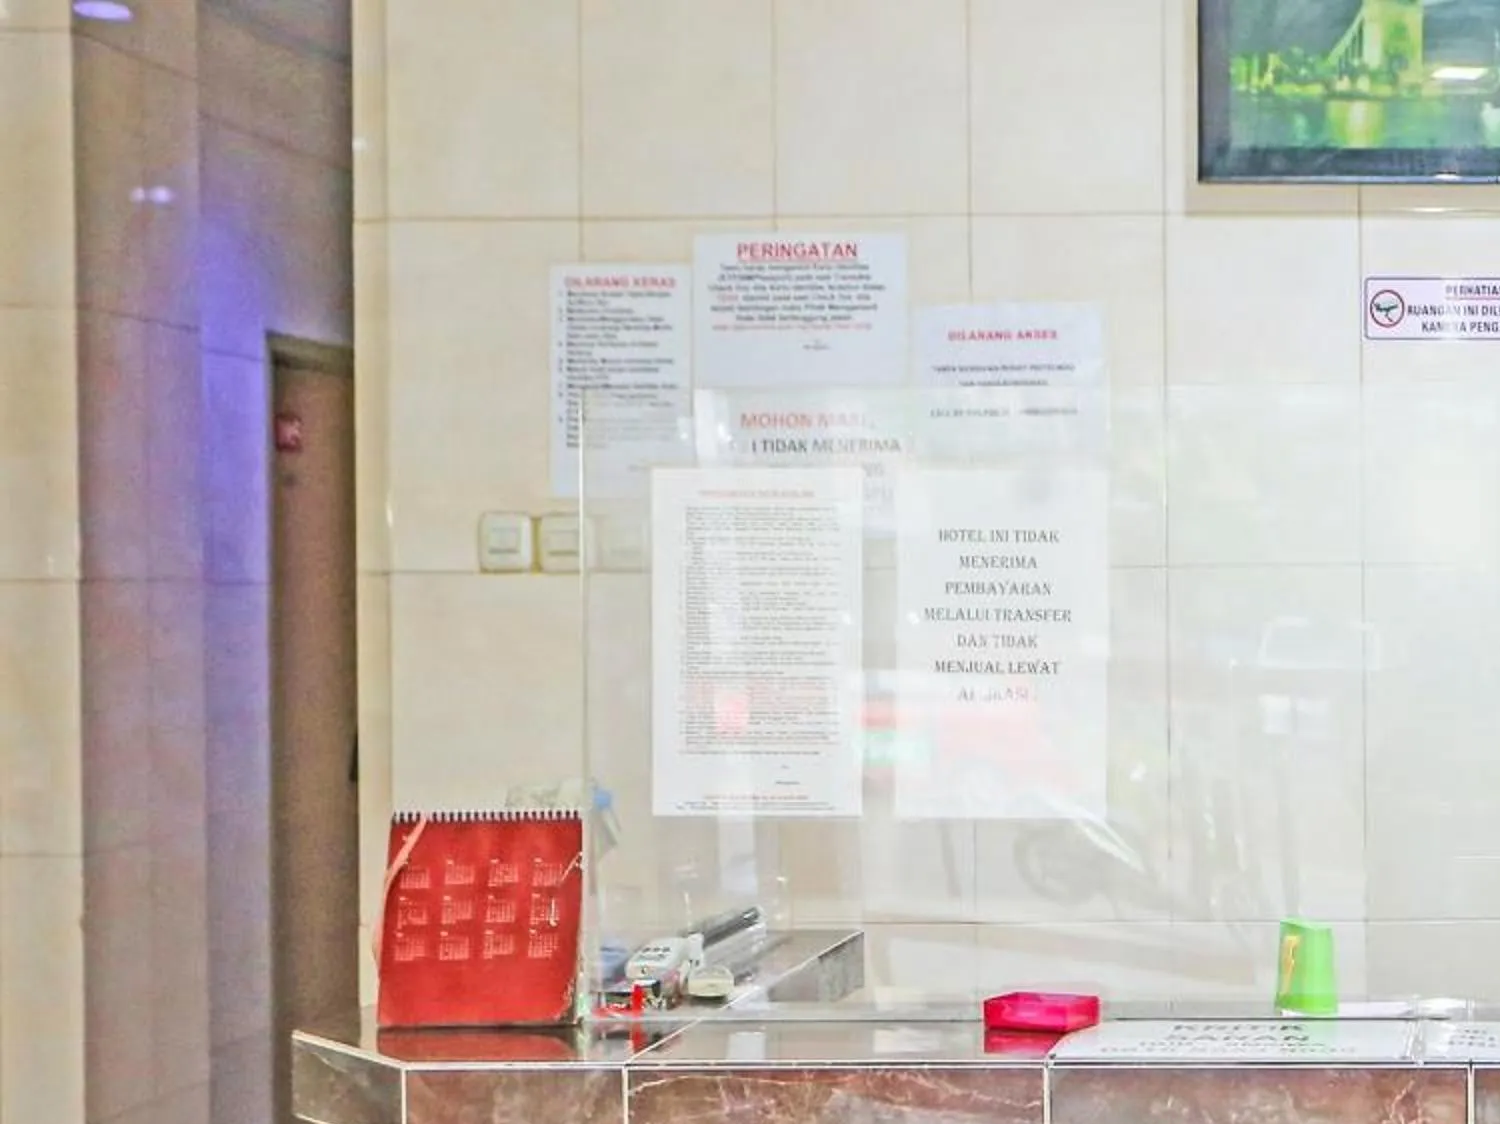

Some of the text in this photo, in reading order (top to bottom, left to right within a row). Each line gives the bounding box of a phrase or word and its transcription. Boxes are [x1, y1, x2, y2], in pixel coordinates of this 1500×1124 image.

[736, 242, 858, 257] PERINGATAN
[1463, 304, 1479, 317] INI
[1421, 321, 1467, 333] KAMA
[740, 412, 811, 428] MOHON
[761, 437, 808, 453] TIDAK
[938, 529, 1060, 544] HOTEL INI TIDAK
[959, 555, 1038, 570] MENERIMA
[944, 580, 1053, 596] PEMBAYARAN
[924, 607, 1073, 623] MELALUI TRANSFER
[957, 633, 1038, 649] DAN TIDAK
[933, 659, 1061, 675] MENJUAL LEWAT
